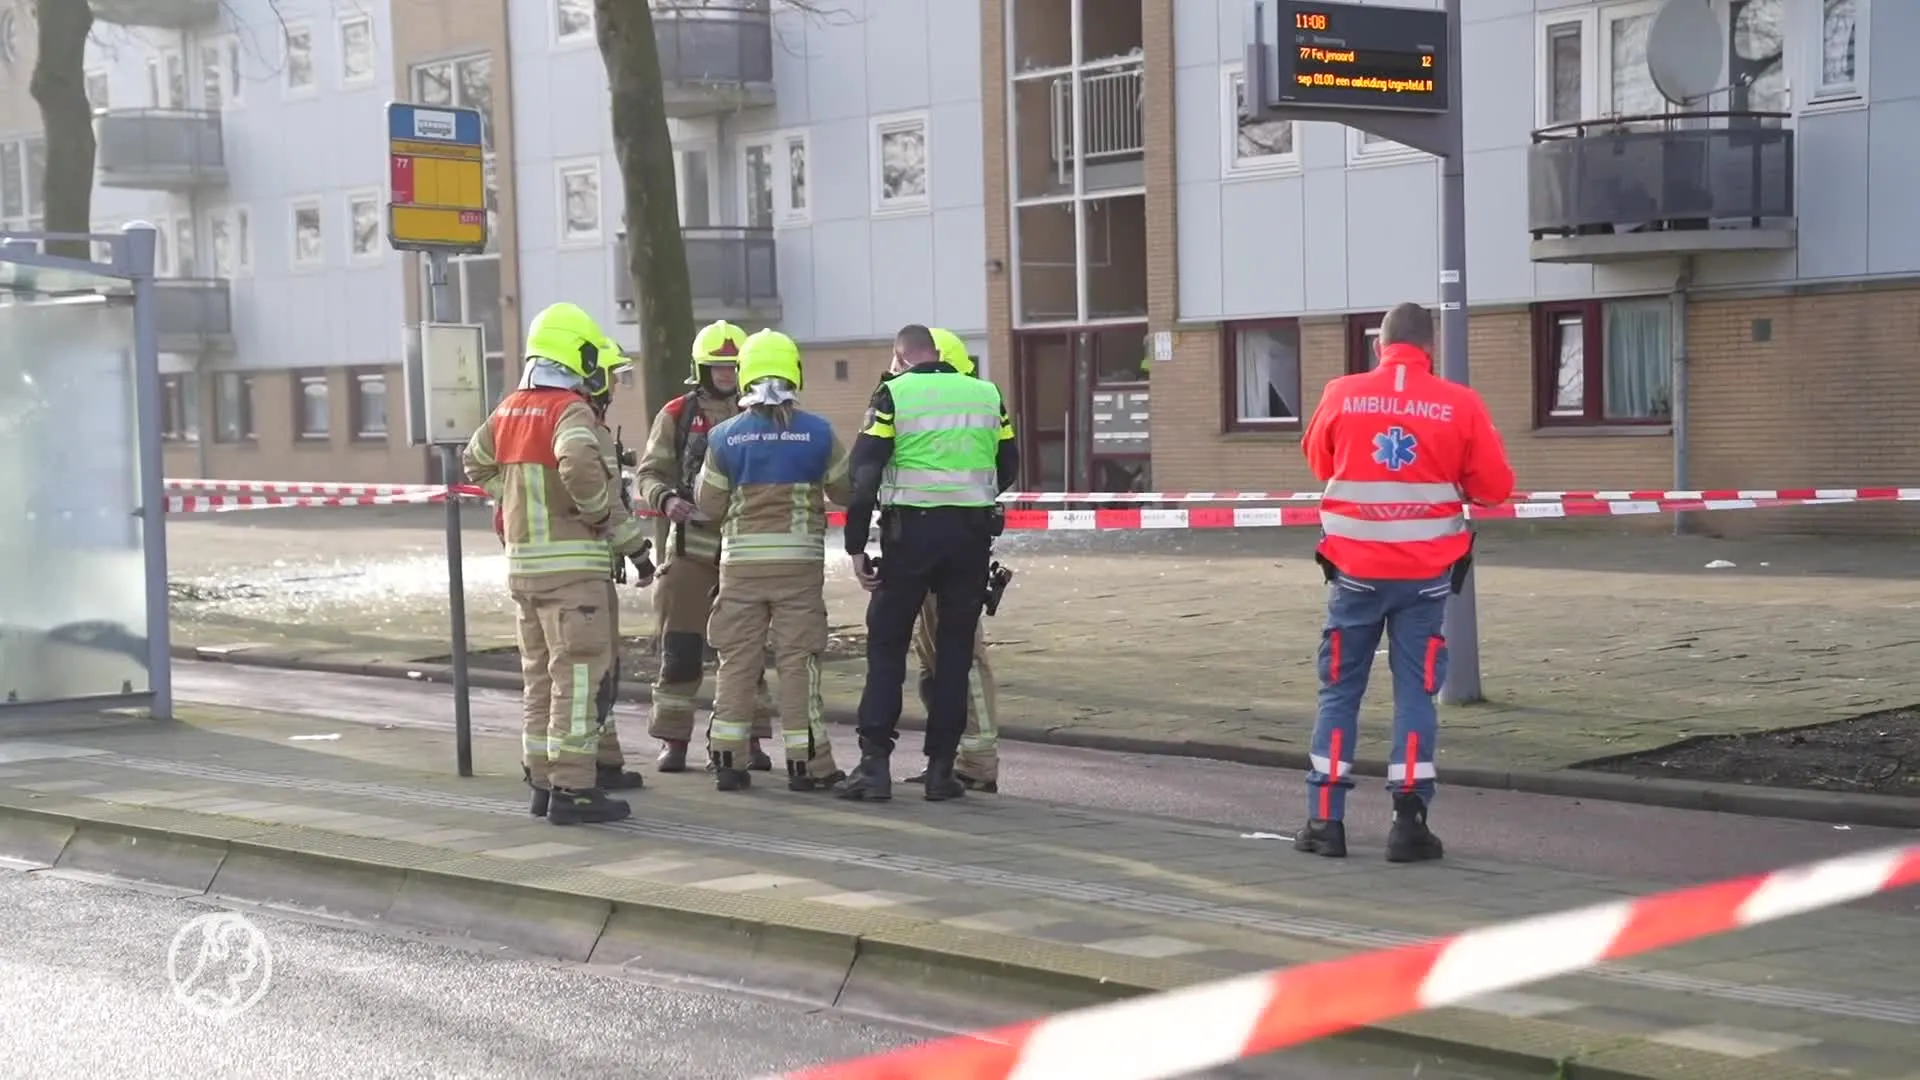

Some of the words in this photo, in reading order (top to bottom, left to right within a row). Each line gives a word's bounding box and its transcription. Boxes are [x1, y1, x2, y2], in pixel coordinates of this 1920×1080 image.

[1296, 13, 1326, 29] 11:08
[1300, 47, 1311, 59] 77
[1422, 55, 1432, 67] 12
[1298, 74, 1313, 86] sep
[1335, 77, 1350, 87] een
[396, 158, 409, 168] 77
[1342, 396, 1454, 422] AMBULANCE
[727, 432, 760, 447] Officier
[762, 432, 778, 441] van
[781, 431, 811, 442] dienst
